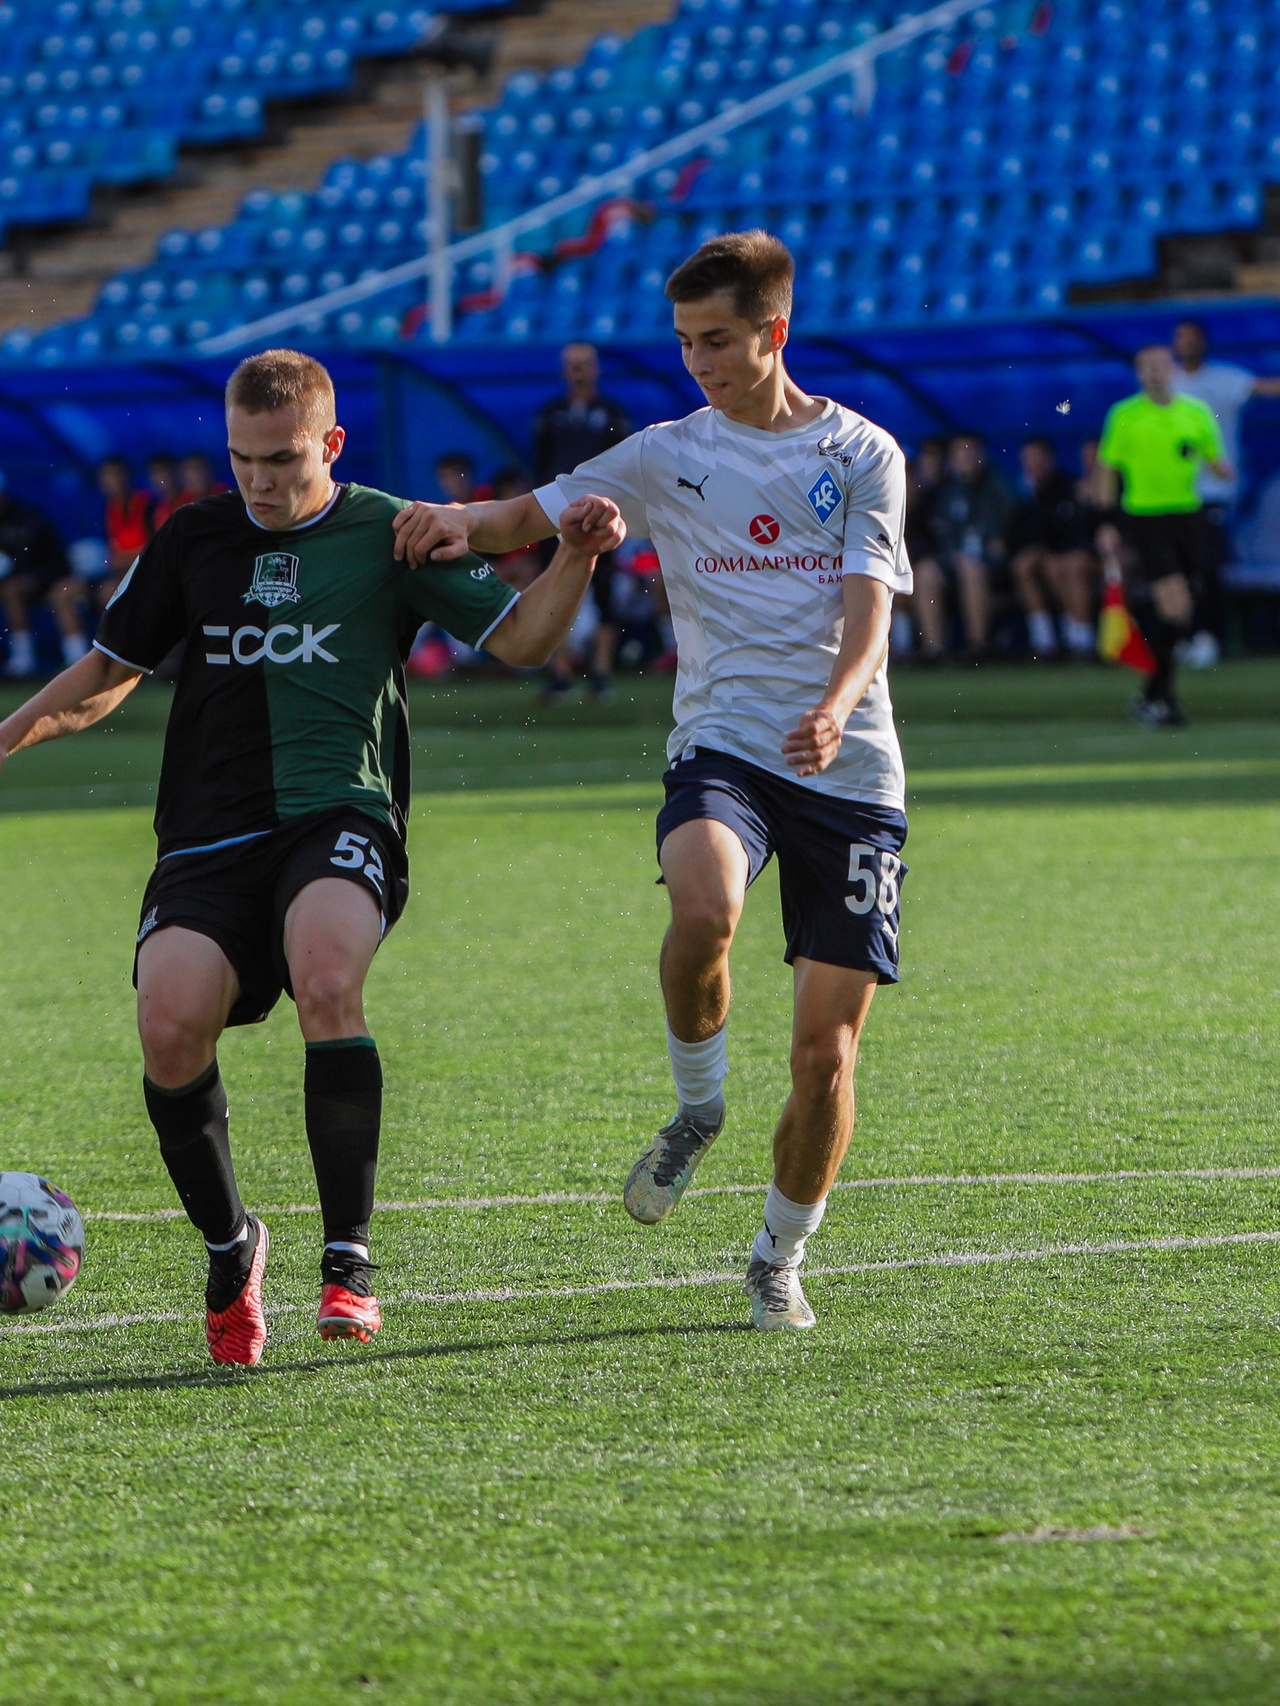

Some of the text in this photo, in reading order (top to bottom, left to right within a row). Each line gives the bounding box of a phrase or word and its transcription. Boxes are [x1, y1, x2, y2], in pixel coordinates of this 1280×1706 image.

[818, 573, 843, 584] БАН
[329, 830, 385, 896] 52
[844, 843, 901, 915] 58
